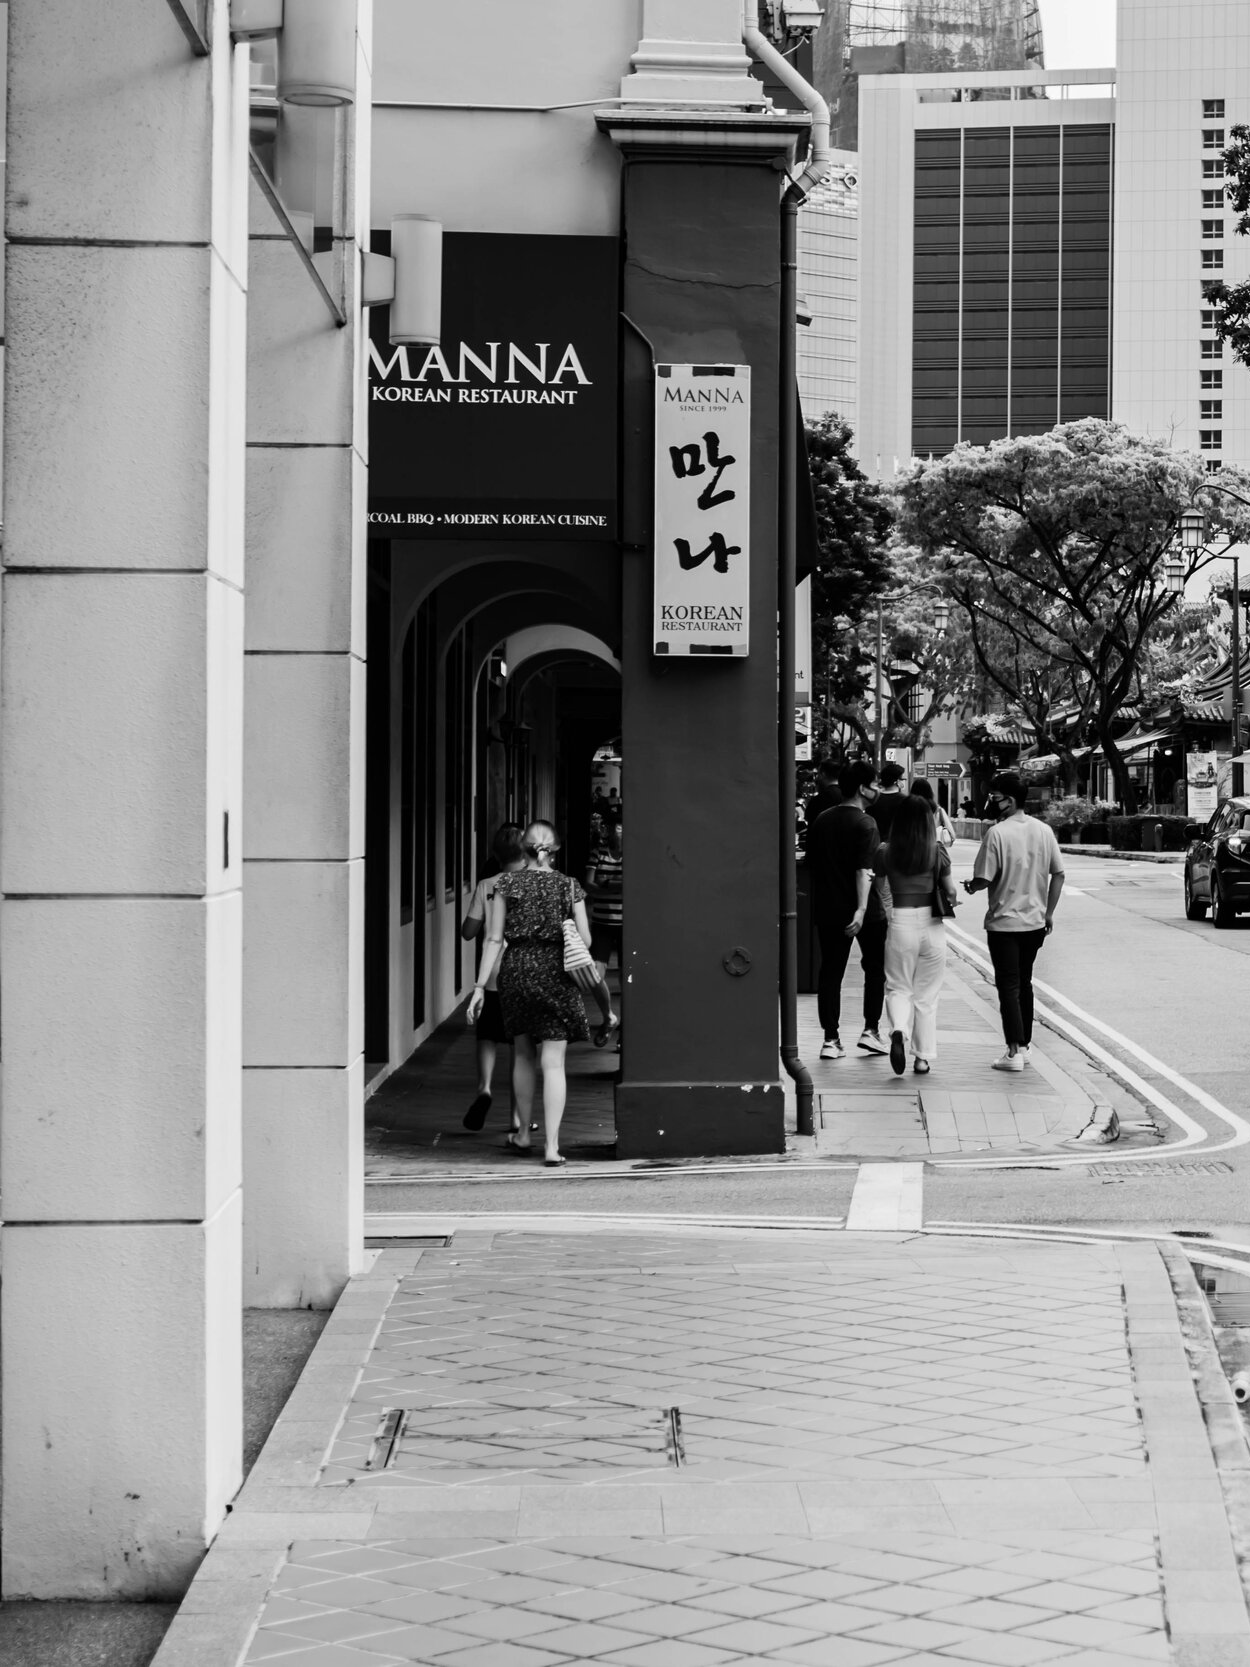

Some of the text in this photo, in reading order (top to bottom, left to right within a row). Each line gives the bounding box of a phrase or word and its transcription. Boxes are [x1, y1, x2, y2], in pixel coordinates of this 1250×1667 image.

[368, 337, 593, 385] MANNA
[372, 387, 578, 405] KOREAN RESTAURANT
[664, 386, 744, 403] MANNA
[407, 513, 434, 526] BBQ
[444, 513, 499, 525] MODERN
[503, 514, 556, 525] KOREAN
[558, 514, 607, 527] CUISINE
[661, 605, 743, 620] KOREAN
[661, 621, 743, 632] RESTAURANT
